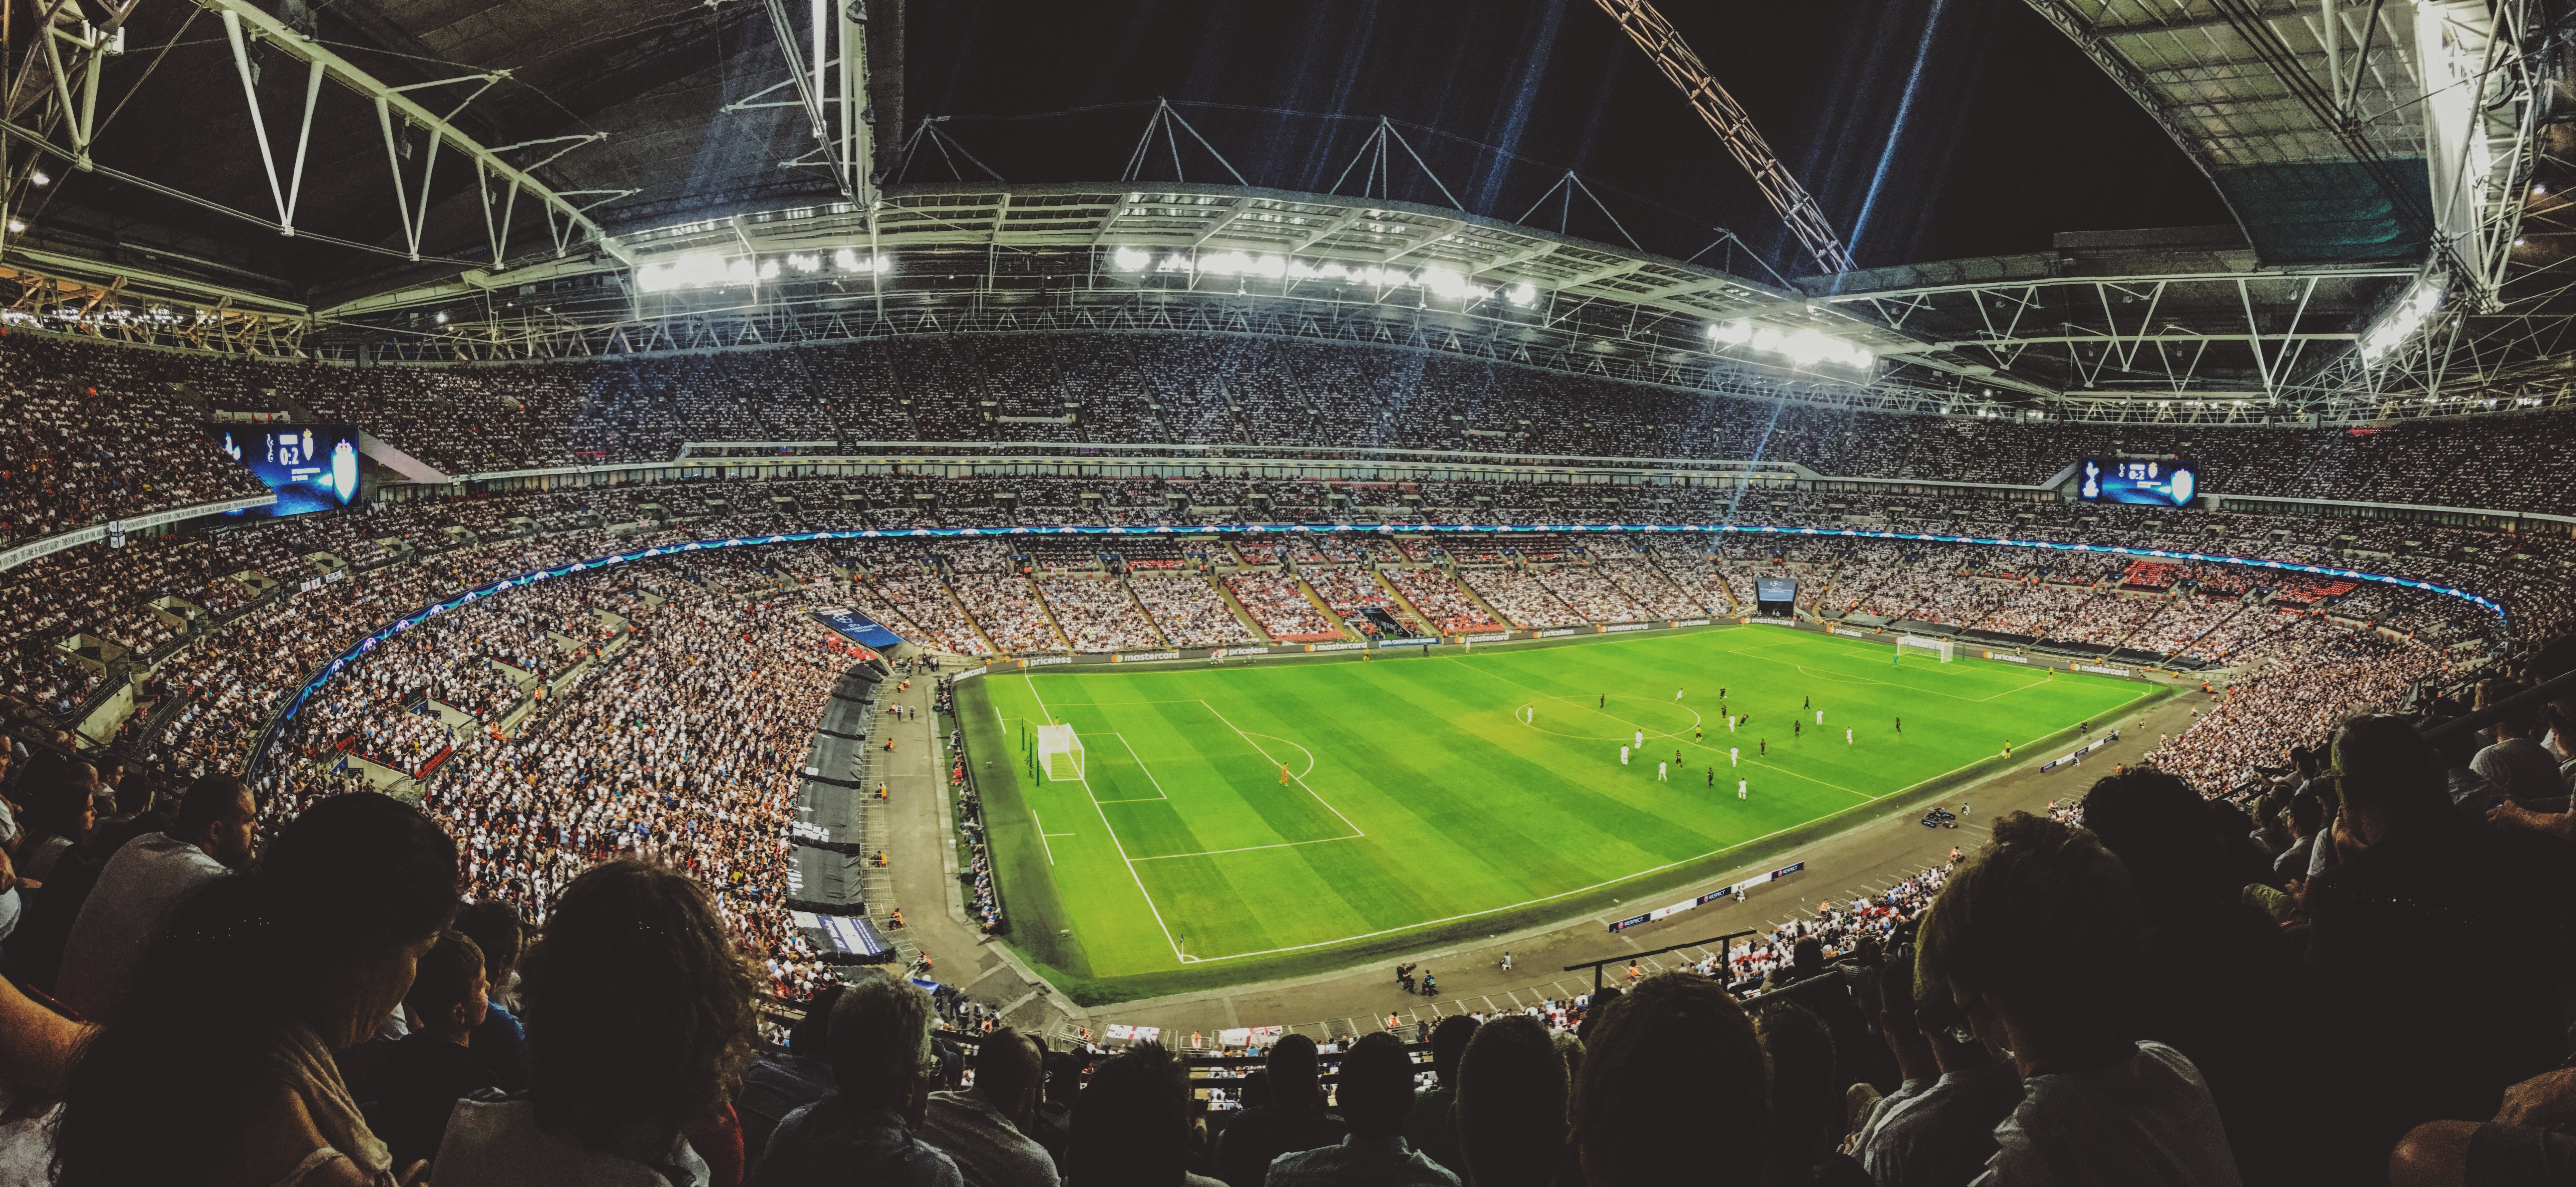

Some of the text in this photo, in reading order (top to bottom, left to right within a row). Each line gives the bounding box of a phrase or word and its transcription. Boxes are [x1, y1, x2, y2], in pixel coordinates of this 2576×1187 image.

[280, 448, 299, 465] 0:2
[2129, 470, 2144, 479] 0:2
[1752, 618, 1794, 626] mastercard
[1543, 629, 1574, 637] priceless
[1835, 628, 1862, 638] priceless
[1466, 634, 1509, 643] mastercard
[1317, 641, 1367, 651] mastercard
[1229, 647, 1268, 656] priceless
[1125, 652, 1179, 661] mastercard
[1994, 654, 2027, 663] priceless
[1031, 657, 1072, 667] priceless
[954, 666, 986, 681] astercard
[2082, 665, 2129, 677] mastercard
[1783, 865, 1798, 874] RESPECT
[1709, 890, 1725, 900] RESPECT
[1672, 903, 1688, 912] RESPECT
[1625, 917, 1644, 926] RESPECT
